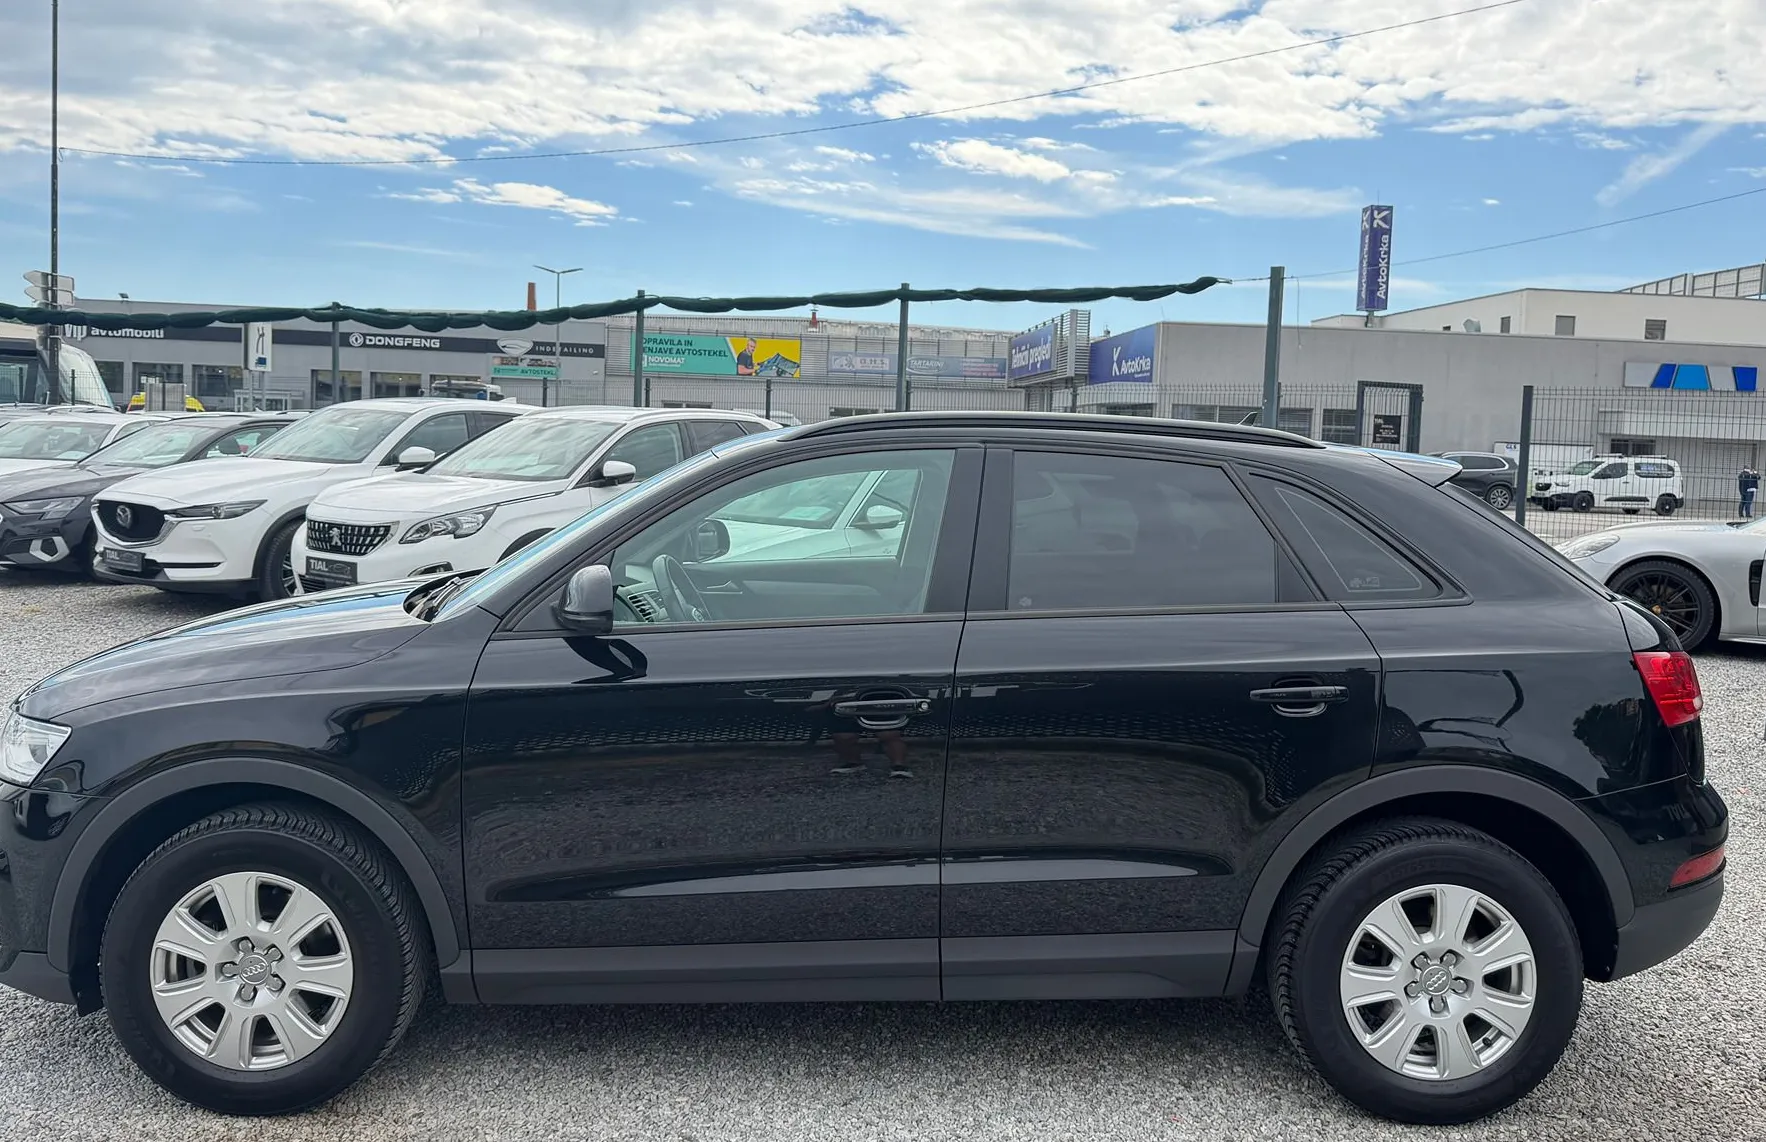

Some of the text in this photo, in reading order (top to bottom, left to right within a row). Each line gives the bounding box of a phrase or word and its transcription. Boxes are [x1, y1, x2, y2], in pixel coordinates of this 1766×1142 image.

[1377, 234, 1389, 299] AvtoKrka
[365, 336, 440, 348] DONGFENG
[643, 337, 693, 347] OPRAVILA IN
[643, 346, 729, 358] ENJAVE AVTOSTEKEL
[1029, 334, 1051, 370] pregledi
[648, 355, 685, 364] NOVOMAT
[1120, 355, 1151, 375] AvtoKrka
[105, 549, 120, 560] TIAL
[310, 559, 328, 571] TIAL
